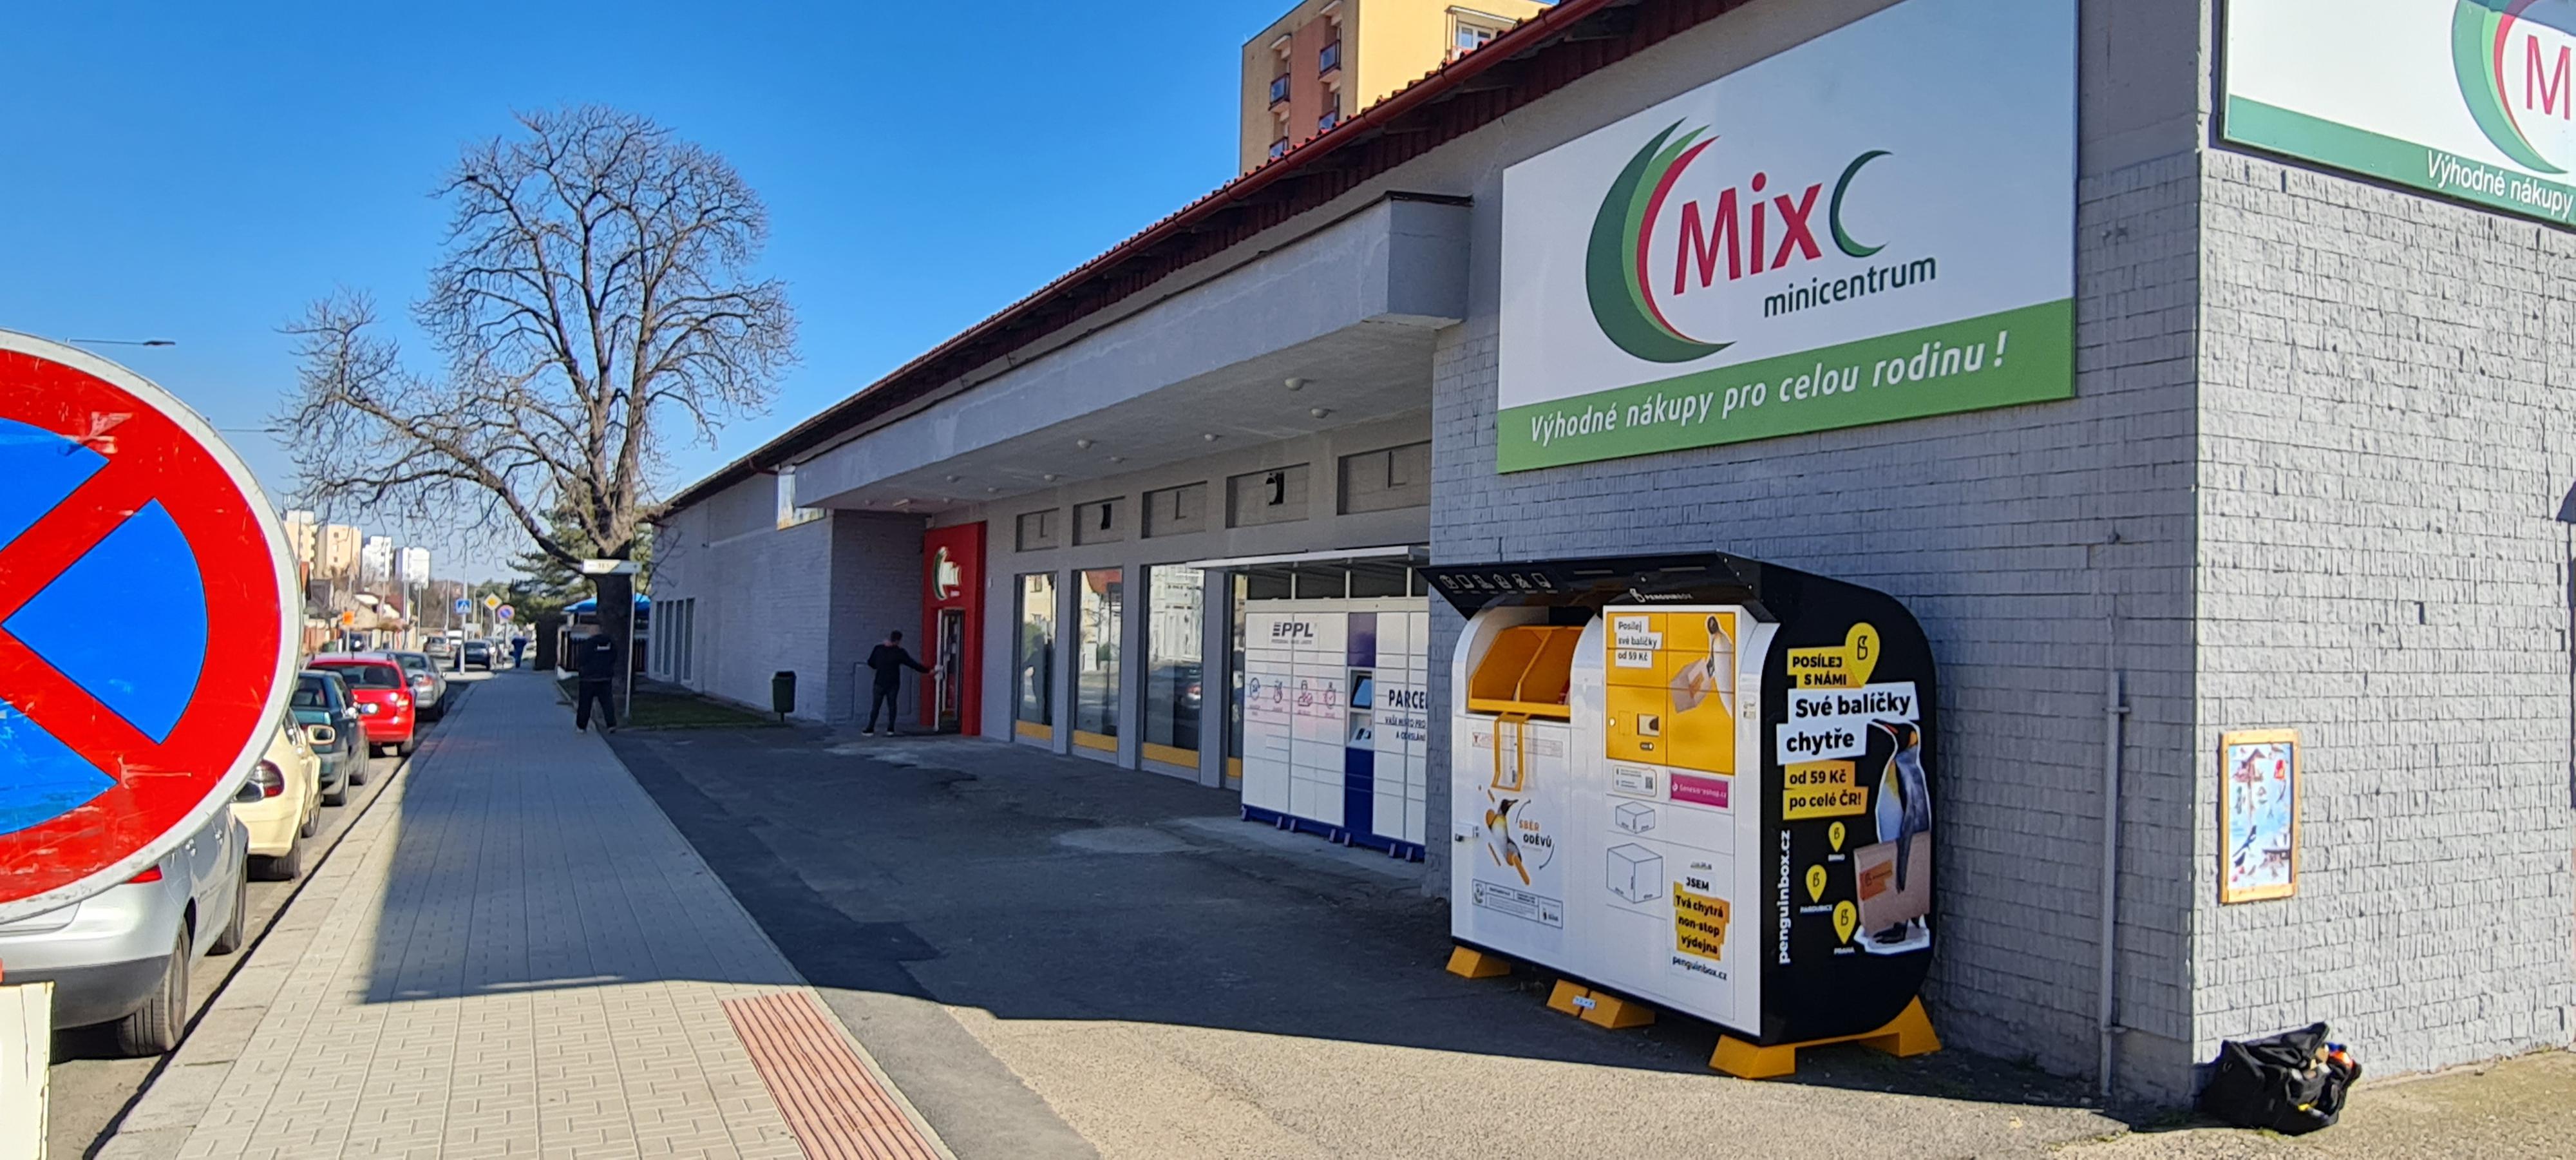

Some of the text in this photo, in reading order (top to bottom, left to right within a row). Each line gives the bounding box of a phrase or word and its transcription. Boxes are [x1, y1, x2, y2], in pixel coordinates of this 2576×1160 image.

[2427, 149, 2573, 220] Výhodné nákupy
[1763, 256, 1937, 319] minicentrum
[1530, 399, 1618, 447] Výhodné
[1625, 386, 1714, 430] nákupy
[1722, 384, 1767, 420] pro
[1779, 363, 1859, 403] celou
[1872, 341, 1985, 388] rodinu
[1282, 622, 1313, 637] PPL
[1618, 651, 1627, 659] od
[1792, 653, 1842, 667] POSÍLEJ
[1804, 671, 1846, 685] S NÁMI
[1795, 692, 1911, 718] Své balíčky
[1786, 728, 1855, 756] chytře
[1789, 770, 1846, 784] od 59 Kč
[1790, 791, 1862, 810] po celé ČR!
[1686, 876, 1709, 891] JSEM
[1676, 895, 1723, 918] Tvá chytrá
[1777, 830, 1791, 964] penguinbox.cz
[1678, 916, 1719, 938] non-stop
[1681, 935, 1718, 954] výdejna
